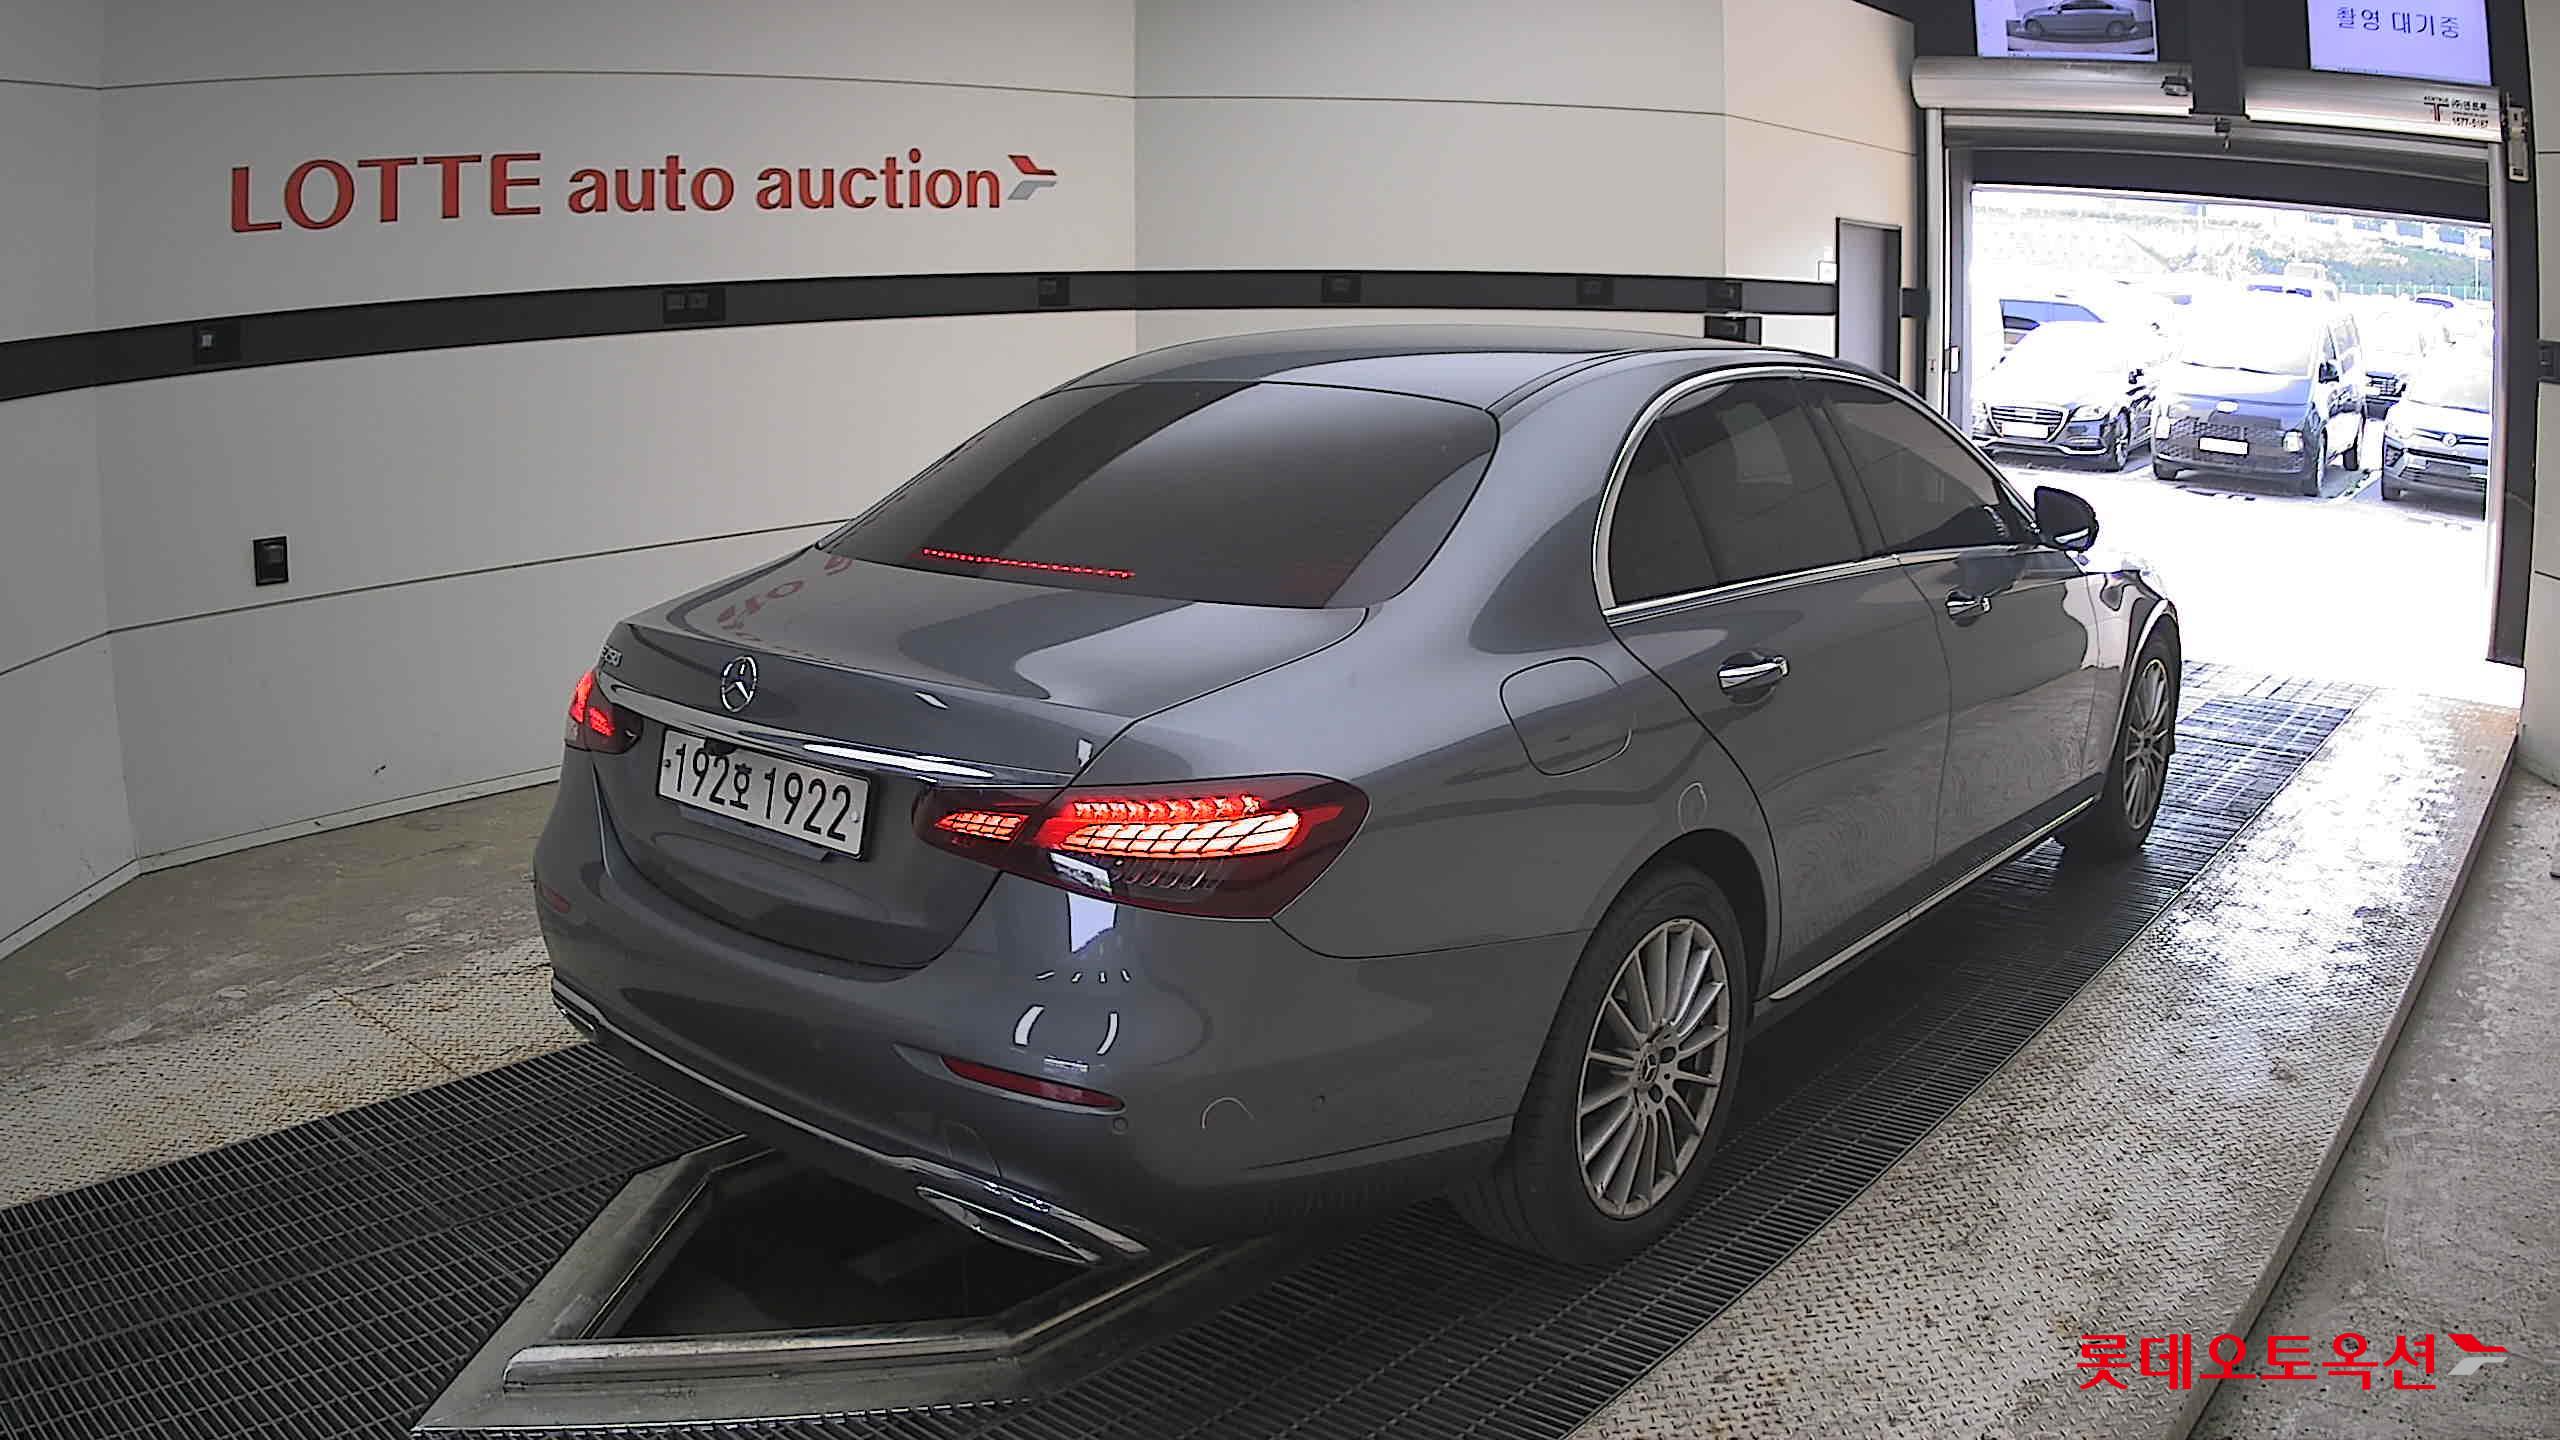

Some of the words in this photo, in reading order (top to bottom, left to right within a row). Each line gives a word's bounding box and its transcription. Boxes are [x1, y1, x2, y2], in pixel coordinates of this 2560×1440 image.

[2337, 6, 2380, 31] 촬영
[2391, 12, 2460, 39] 대기중
[231, 153, 541, 232] LOTTE
[568, 154, 735, 214] auto
[756, 147, 1001, 210] auction
[675, 743, 753, 811] 192호
[764, 767, 852, 842] 1922
